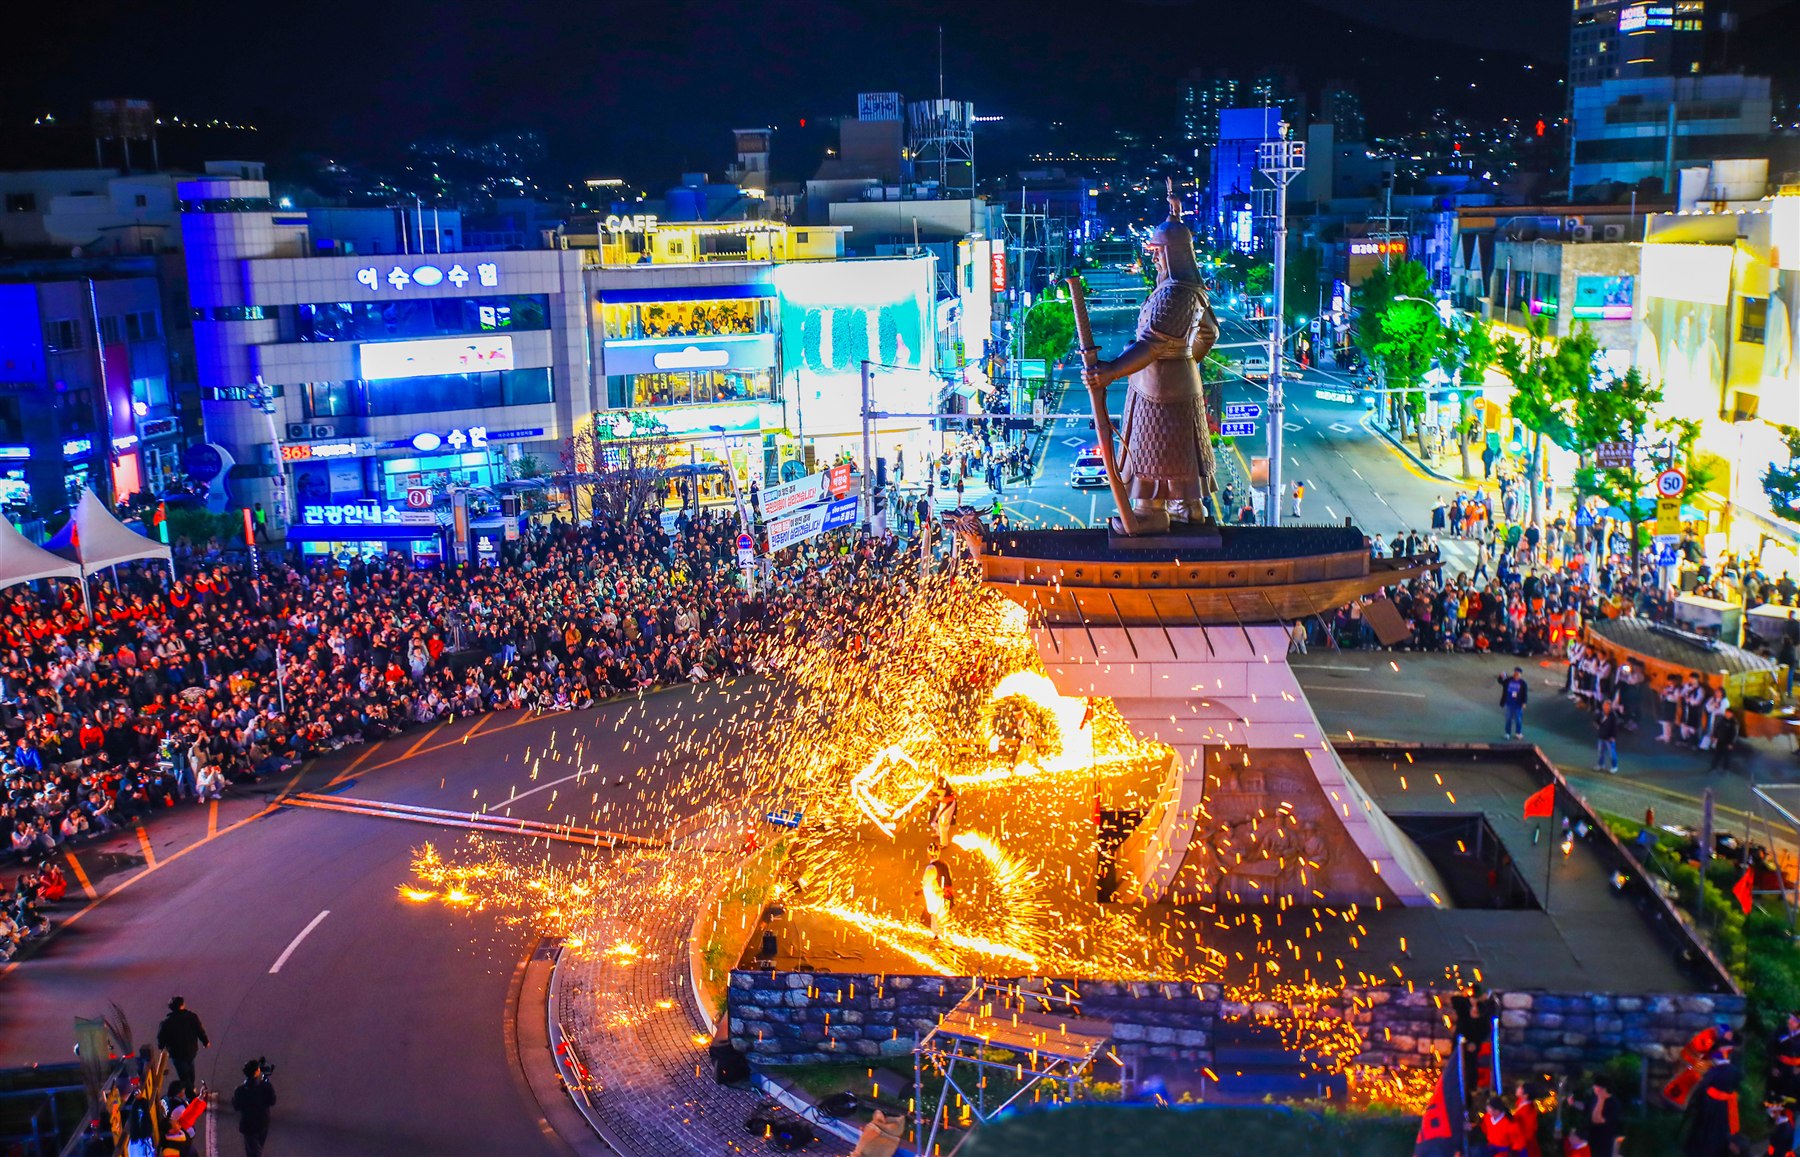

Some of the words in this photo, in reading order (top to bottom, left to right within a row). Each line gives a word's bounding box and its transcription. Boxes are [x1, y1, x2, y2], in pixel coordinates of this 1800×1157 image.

[605, 214, 658, 233] CAFE
[357, 266, 410, 291] 여수
[447, 263, 498, 288] 수협
[447, 426, 487, 449] 수협
[280, 444, 312, 461] 365
[1663, 477, 1680, 490] 50
[304, 503, 402, 525] 관광안내소
